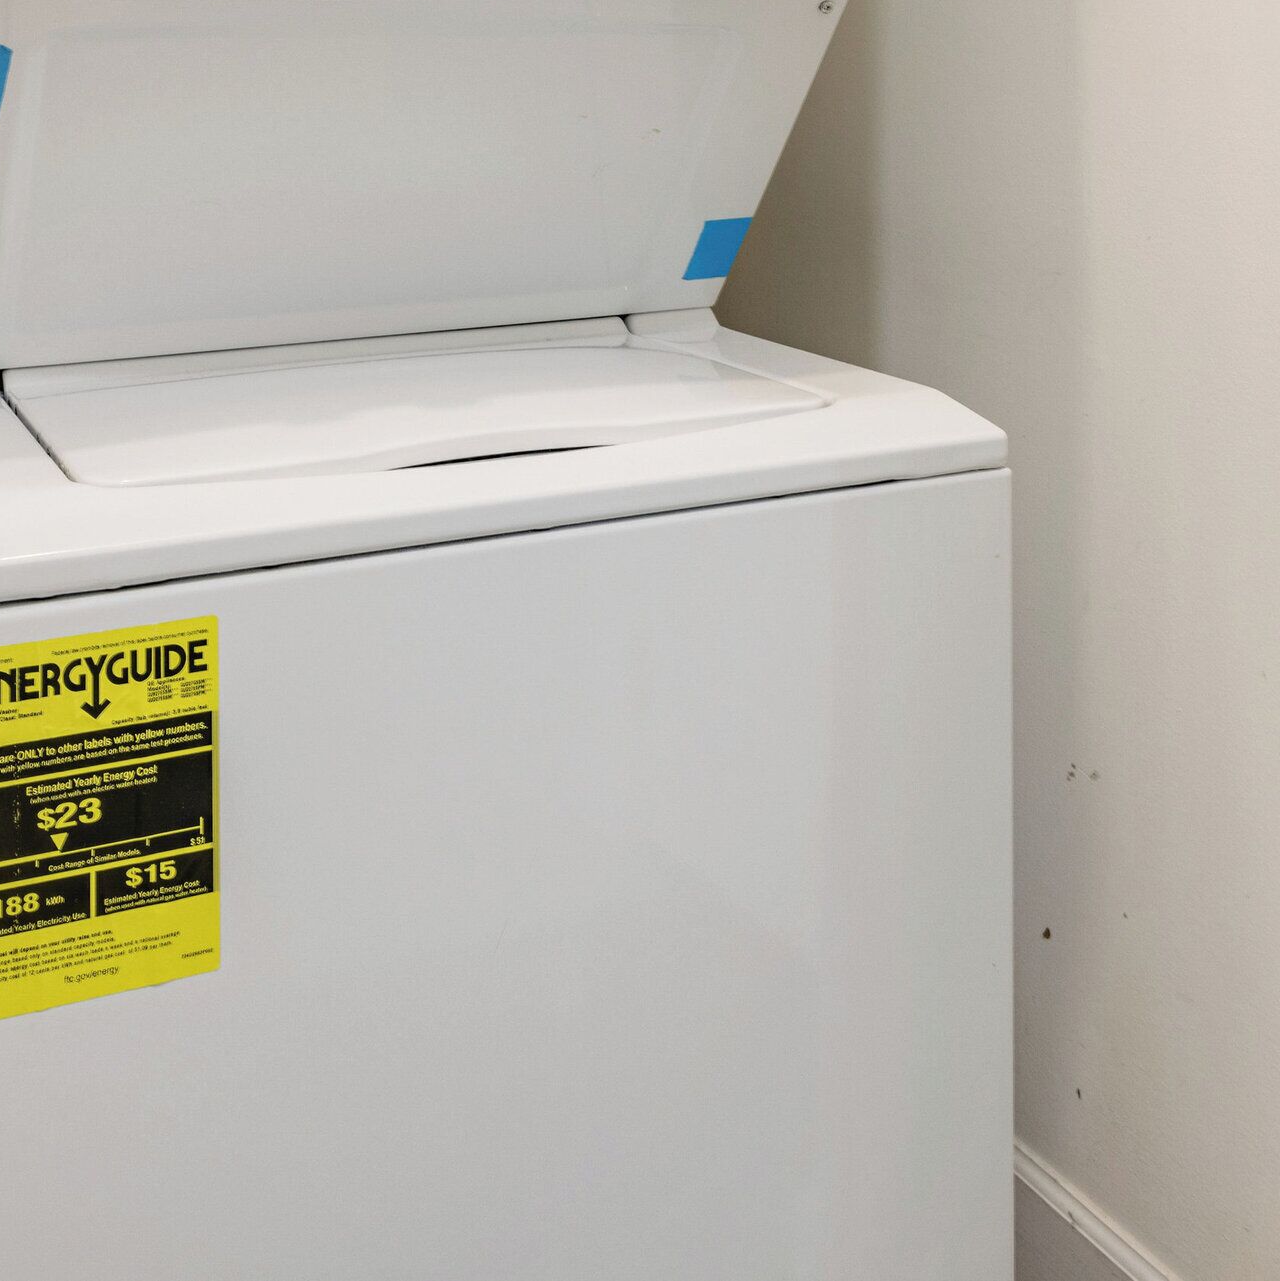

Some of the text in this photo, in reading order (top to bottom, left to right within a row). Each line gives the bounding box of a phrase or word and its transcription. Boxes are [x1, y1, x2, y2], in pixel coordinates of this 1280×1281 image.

[17, 747, 44, 761] ONLY
[45, 746, 56, 756] to
[57, 742, 83, 755] other
[84, 736, 112, 750] labels
[113, 732, 134, 744] with
[134, 728, 164, 742] yellow
[165, 721, 208, 736] numbers.
[0, 764, 16, 774] with
[17, 761, 39, 772] yellow
[41, 756, 72, 767] numbers
[73, 753, 85, 761] are
[85, 748, 107, 759] based
[107, 747, 118, 755] on
[118, 744, 130, 753] the
[131, 742, 150, 751] same
[150, 739, 164, 748] test
[25, 764, 158, 796] Estimated Yearly Energy Cost
[51, 793, 67, 801] used
[116, 781, 133, 789] water
[37, 797, 102, 832] $23
[48, 863, 64, 872] Cost
[65, 859, 86, 869] Range
[95, 853, 117, 863] Similar
[125, 859, 177, 889] $15
[45, 895, 66, 906] kWh
[104, 879, 201, 906] Estimated Yearly Energy Cost
[14, 922, 36, 932] Yearly
[37, 914, 71, 928] Electricity
[72, 911, 87, 920] Use
